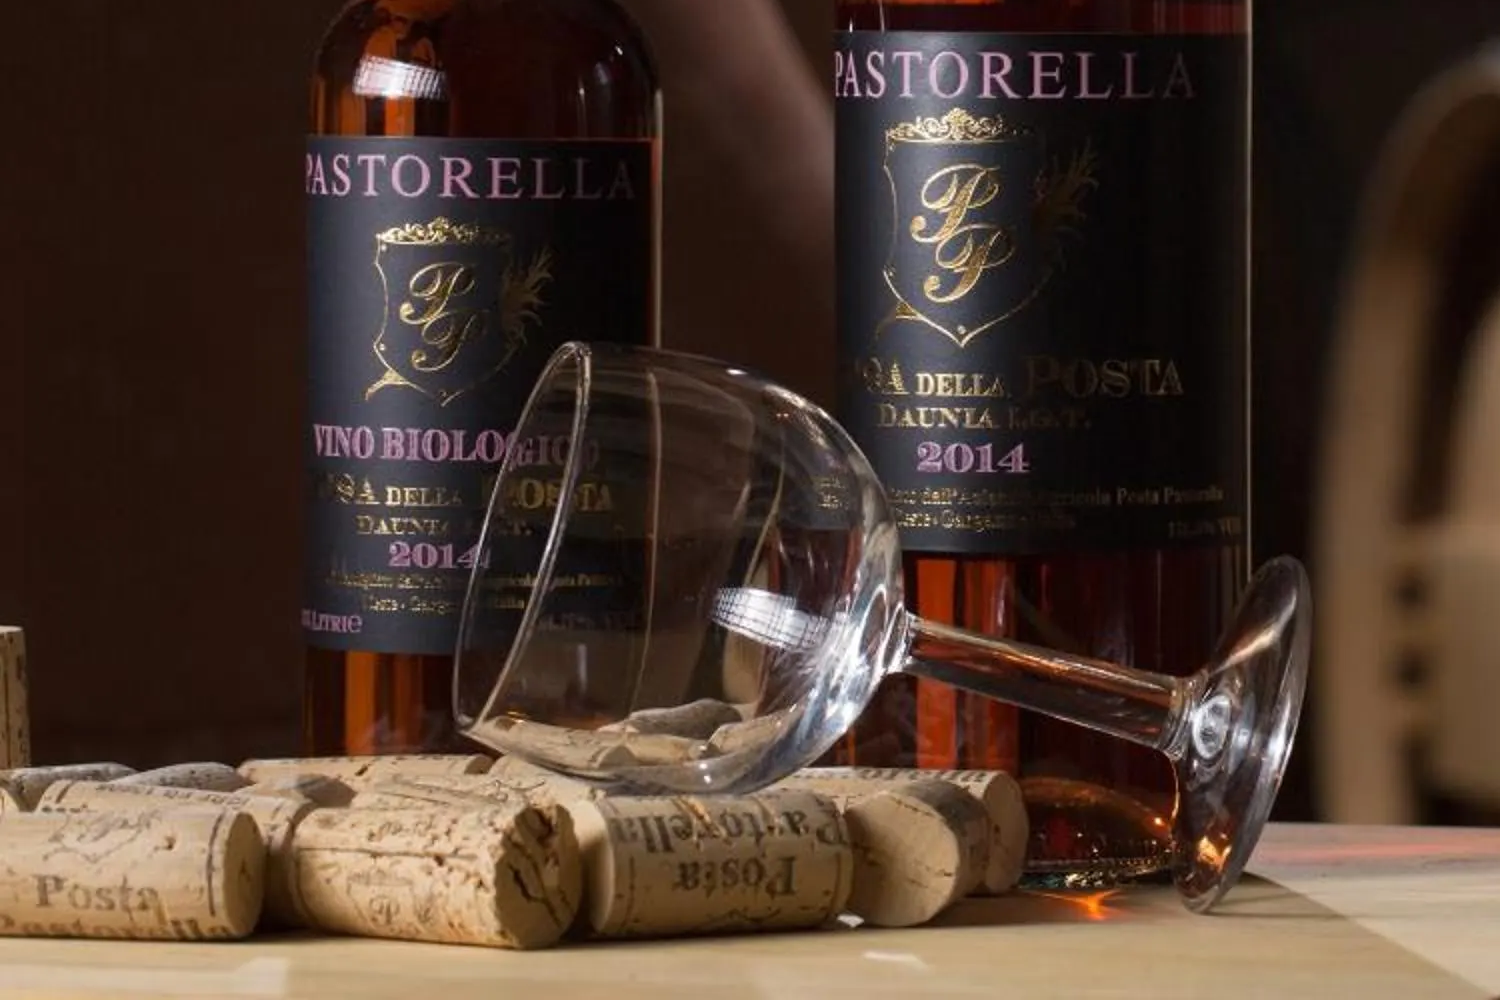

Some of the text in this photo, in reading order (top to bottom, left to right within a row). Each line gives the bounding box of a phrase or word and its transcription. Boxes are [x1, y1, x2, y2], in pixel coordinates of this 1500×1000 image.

[834, 50, 1196, 99] PASTORELLA
[915, 372, 1006, 397] DELLA
[313, 424, 374, 459] VINO
[916, 441, 1031, 473] 2014
[388, 541, 491, 569] 2014
[33, 872, 161, 912] Posta
[672, 855, 798, 897] Posta
